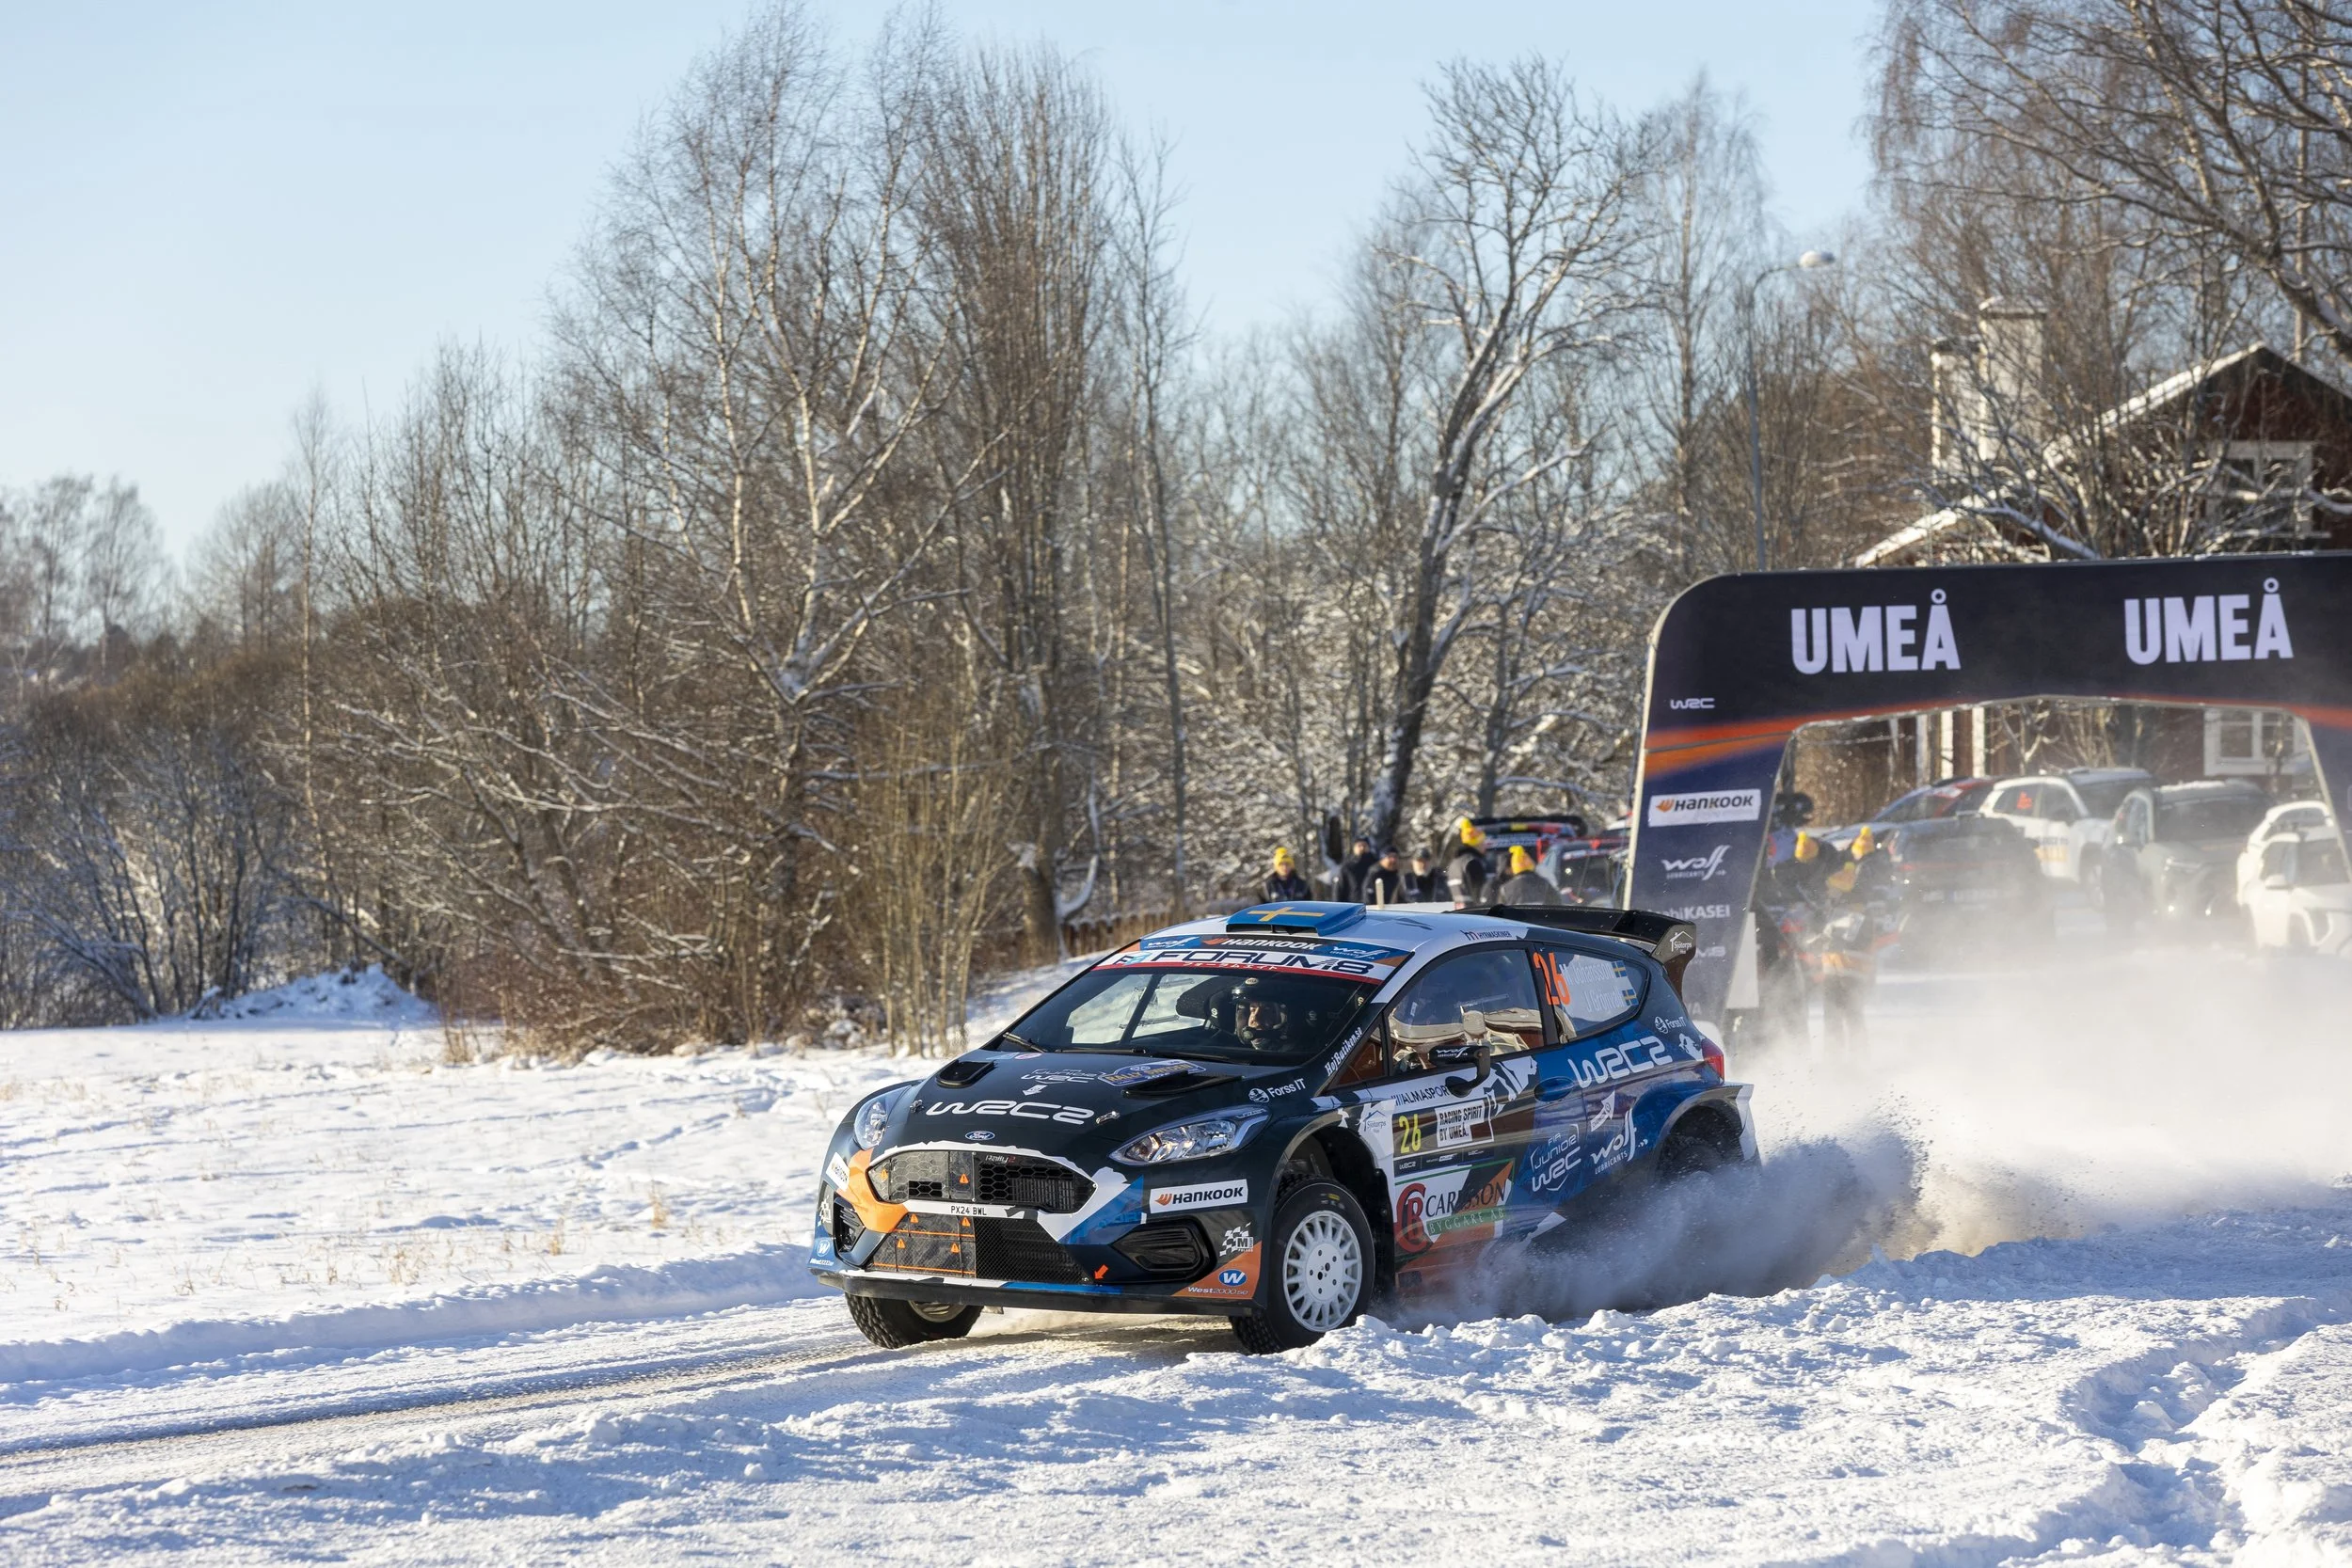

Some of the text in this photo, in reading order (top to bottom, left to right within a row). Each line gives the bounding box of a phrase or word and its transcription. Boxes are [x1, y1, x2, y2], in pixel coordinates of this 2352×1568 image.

[1790, 588, 1961, 674] UMEÅ
[2123, 577, 2294, 665] UMEÅ
[1670, 697, 1715, 709] WRC
[1151, 950, 1375, 975] FORUM8
[1533, 951, 1570, 1006] 26
[1567, 1035, 1673, 1088] WRC2
[1266, 1078, 1306, 1098] Forss IT
[1401, 1085, 1451, 1105] ALMASPOR
[925, 1100, 1095, 1125] WRC2
[1439, 1105, 1483, 1126] RACING SPIRIT
[969, 1131, 991, 1140] Ford
[1399, 1114, 1422, 1153] 26
[1439, 1128, 1448, 1141] BY
[1548, 1132, 1561, 1147] FIA
[1590, 1108, 1637, 1162] wolf
[1532, 1146, 1581, 1192] WRC
[1595, 1149, 1629, 1175] LUBRICANTS
[950, 1206, 987, 1215] PX24 BWL
[1425, 1180, 1507, 1217] CARSON
[1430, 1208, 1505, 1233] BYGGARE AB
[1223, 1272, 1245, 1284] W
